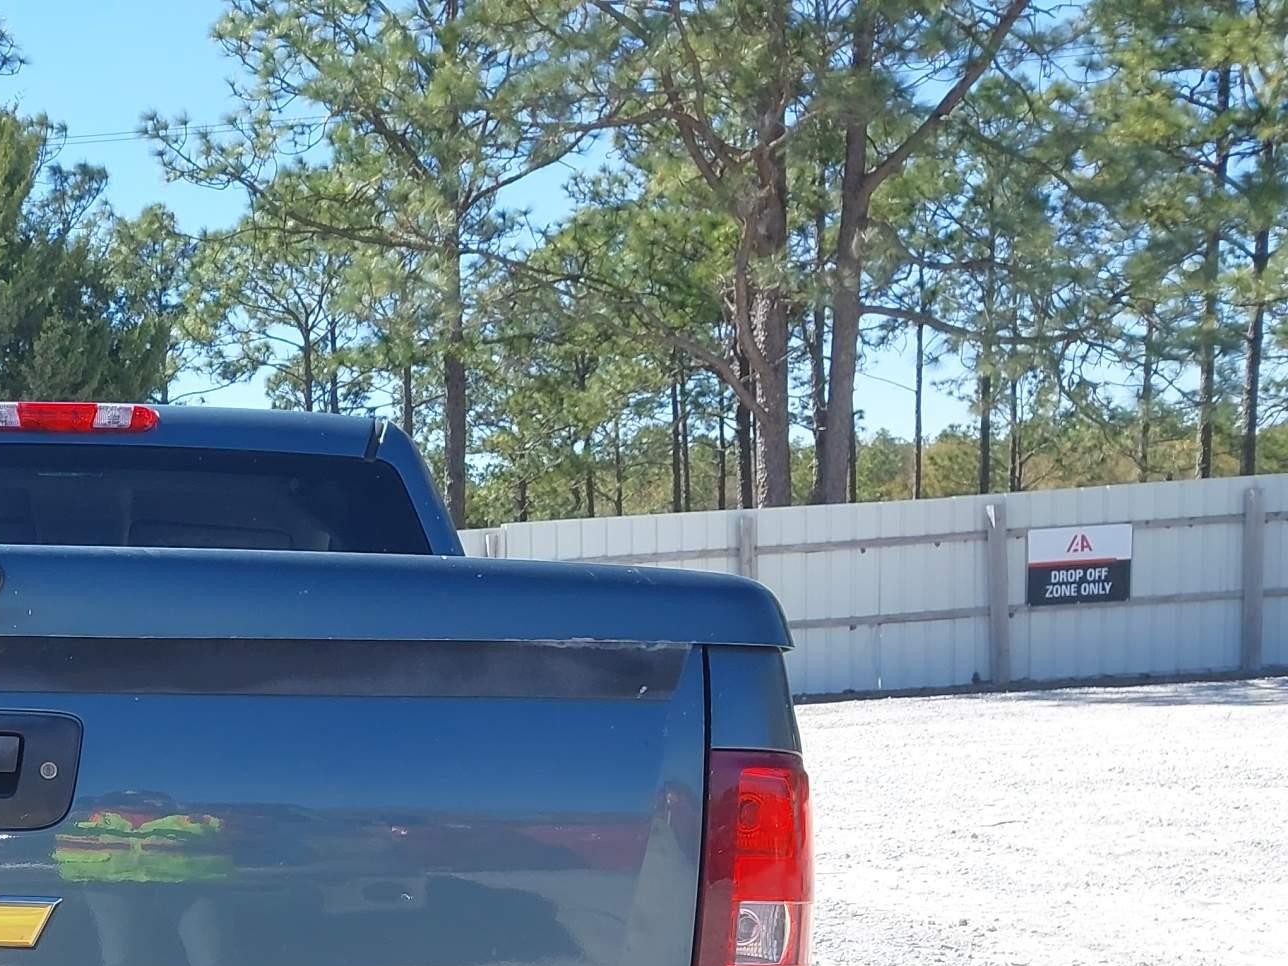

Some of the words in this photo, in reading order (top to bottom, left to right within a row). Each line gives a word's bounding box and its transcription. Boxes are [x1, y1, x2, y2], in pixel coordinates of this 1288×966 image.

[1051, 569, 1084, 583] DROP
[1086, 568, 1109, 581] OFF
[1045, 584, 1078, 598] ZONE
[1080, 582, 1113, 595] ONLY
